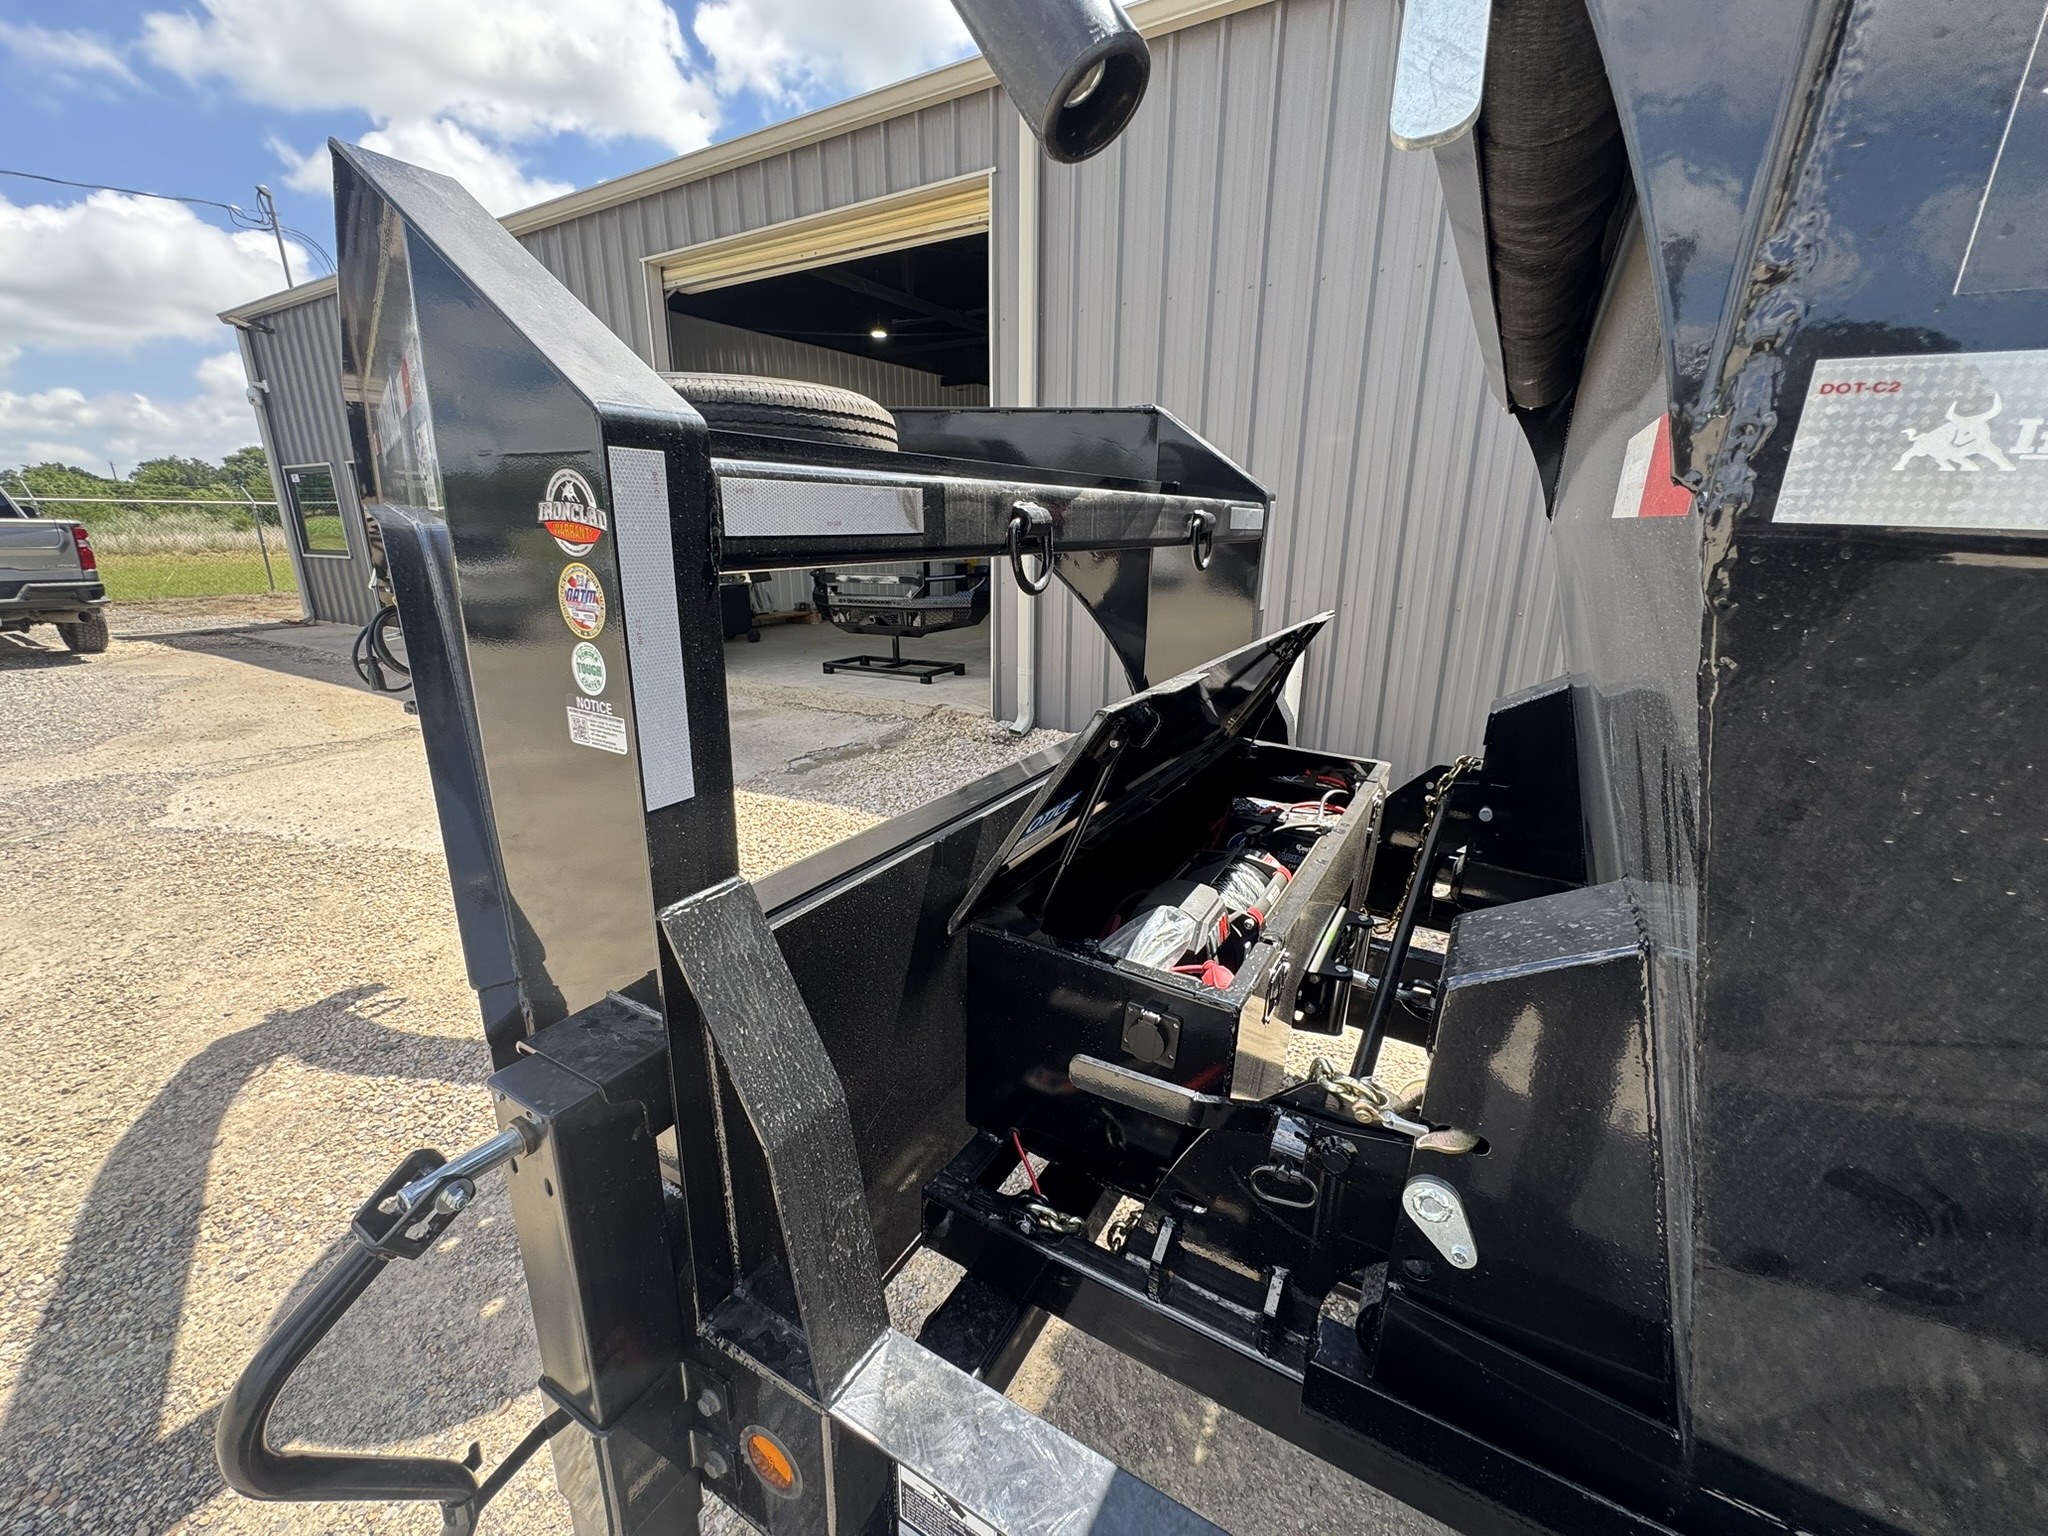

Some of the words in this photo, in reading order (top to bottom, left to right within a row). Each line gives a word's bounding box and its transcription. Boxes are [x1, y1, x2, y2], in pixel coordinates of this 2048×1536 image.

[1819, 381, 1902, 395] DOT-C2
[537, 501, 608, 532] IRONCLAD
[552, 523, 596, 540] WARRANTY
[576, 662, 602, 677] TOUGH
[576, 696, 613, 715] NOTICE
[1026, 790, 1083, 833] OTICE
